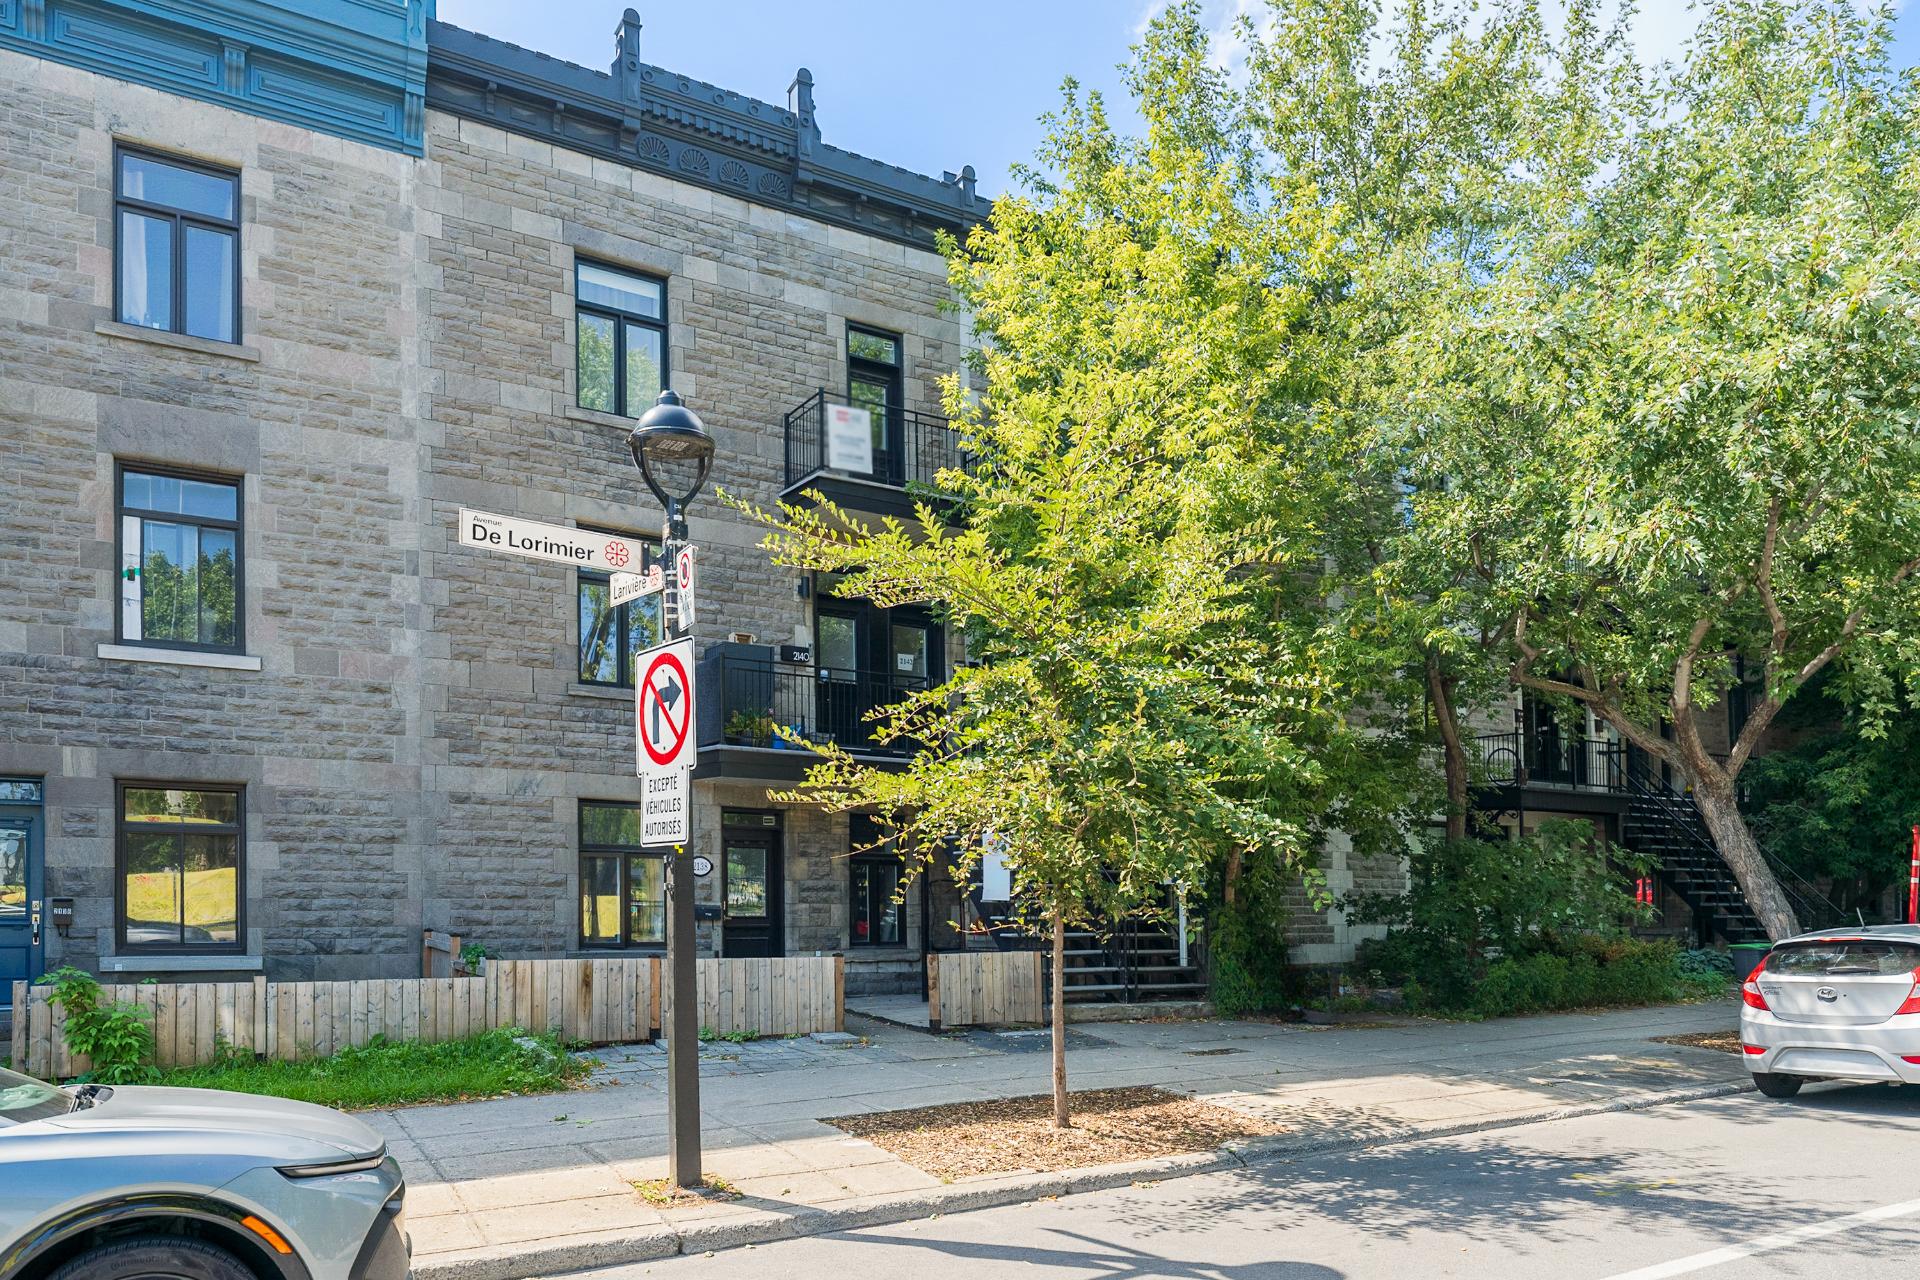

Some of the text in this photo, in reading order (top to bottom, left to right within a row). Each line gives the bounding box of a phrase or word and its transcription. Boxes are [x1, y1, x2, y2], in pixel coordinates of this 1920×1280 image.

[473, 515, 502, 526] Avenue
[472, 523, 595, 560] De Lorimier
[613, 576, 647, 600] Larivière
[792, 651, 810, 662] 2140
[649, 772, 678, 793] EXCEPTÉ
[645, 797, 682, 815] VÉHICULES
[644, 816, 682, 836] AUTORISÉS
